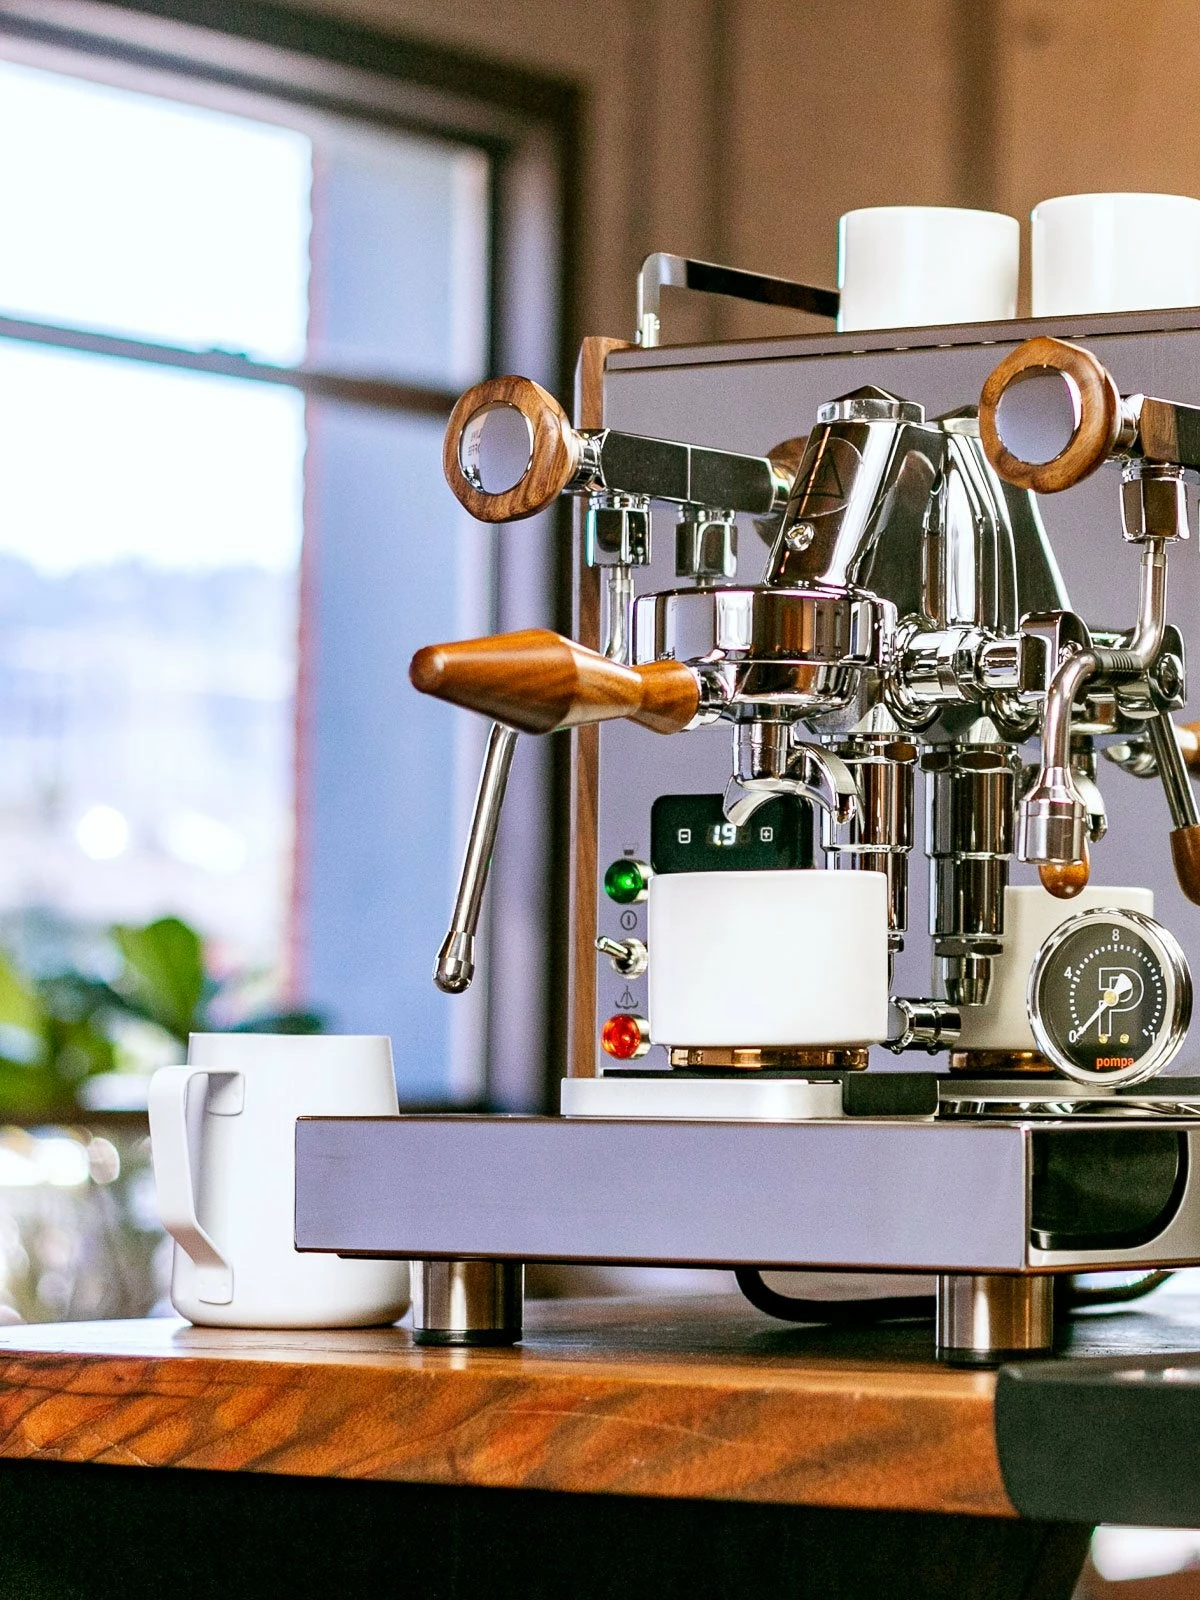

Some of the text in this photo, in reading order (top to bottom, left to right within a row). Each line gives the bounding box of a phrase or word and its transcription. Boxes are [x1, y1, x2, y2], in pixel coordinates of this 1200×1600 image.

[1112, 929, 1120, 942] 8
[1064, 966, 1073, 979] 4
[1096, 1057, 1135, 1070] pompa
